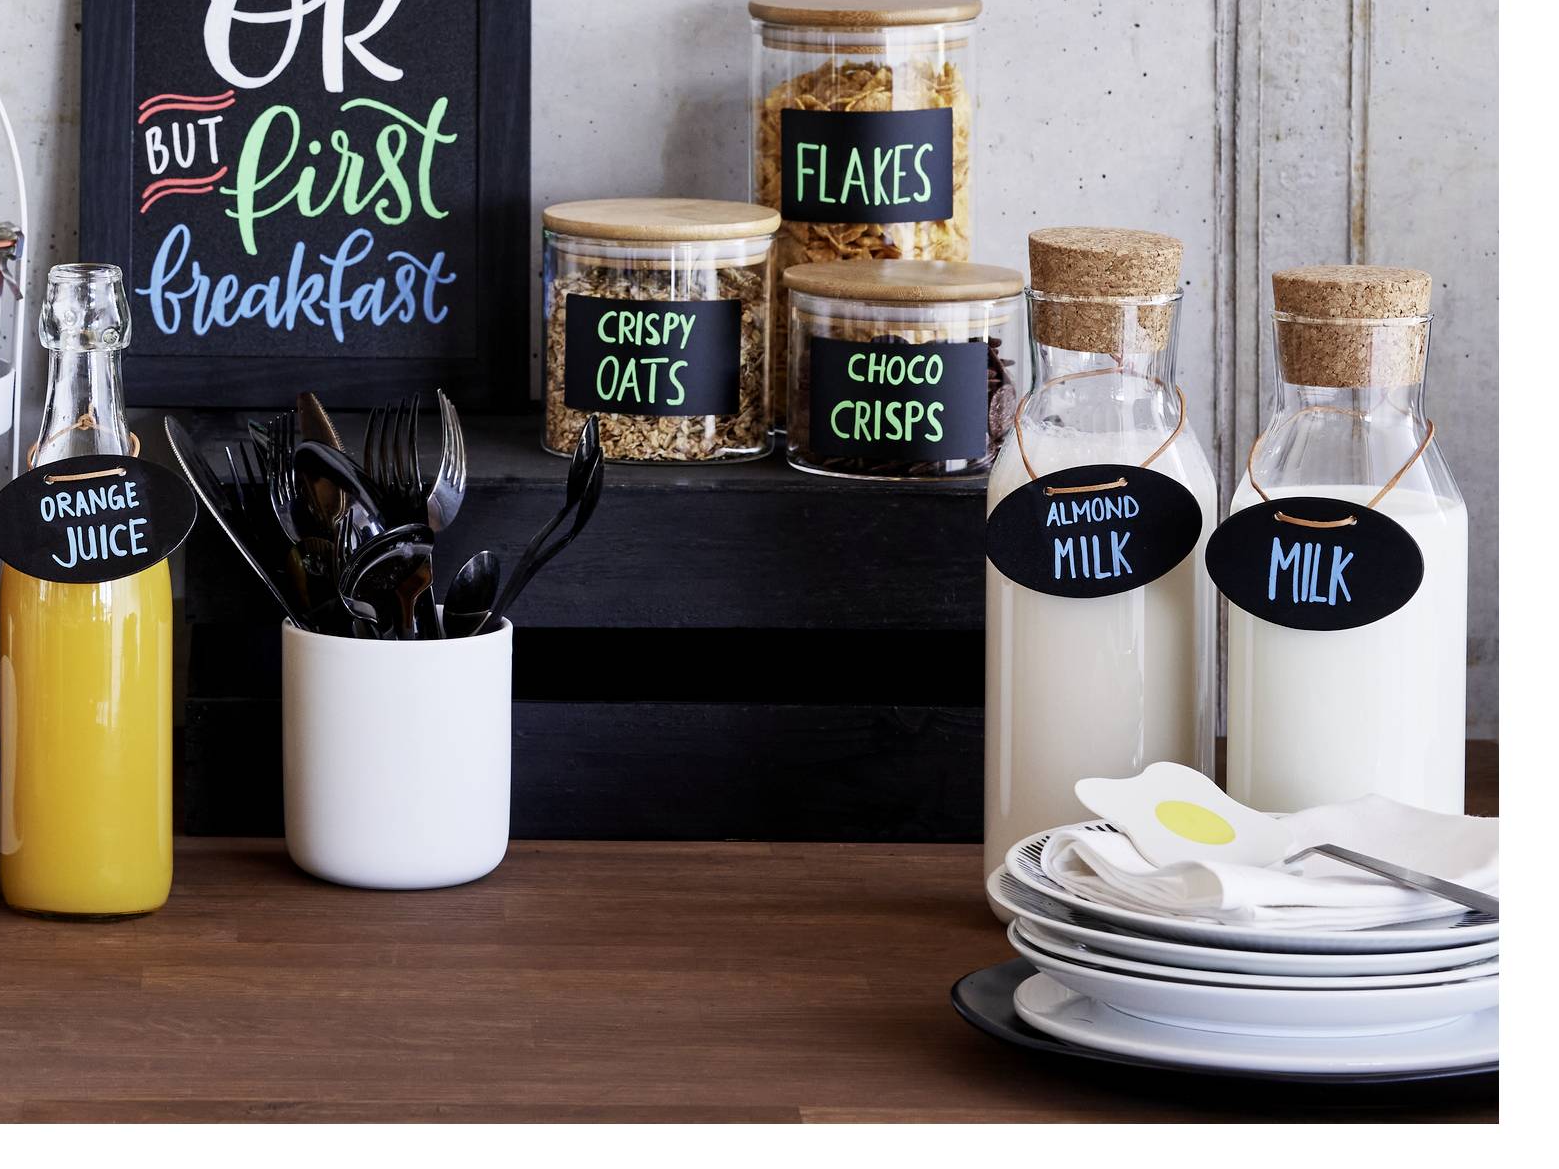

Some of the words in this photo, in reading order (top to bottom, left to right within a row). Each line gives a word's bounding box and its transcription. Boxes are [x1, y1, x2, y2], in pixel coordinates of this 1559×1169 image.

[145, 115, 223, 176] BUT
[220, 97, 457, 255] first
[797, 142, 934, 206] FLAKES
[135, 223, 457, 344] breakfast
[597, 310, 697, 348] CRISPY
[595, 356, 690, 406] OATS
[847, 352, 944, 386] CHOCO
[830, 400, 945, 443] CRISPS
[40, 481, 141, 520] ORANGE
[1046, 495, 1140, 527] ALMOND
[51, 517, 148, 569] JUICE
[1054, 530, 1133, 580] MILK
[1268, 536, 1354, 606] MILK
